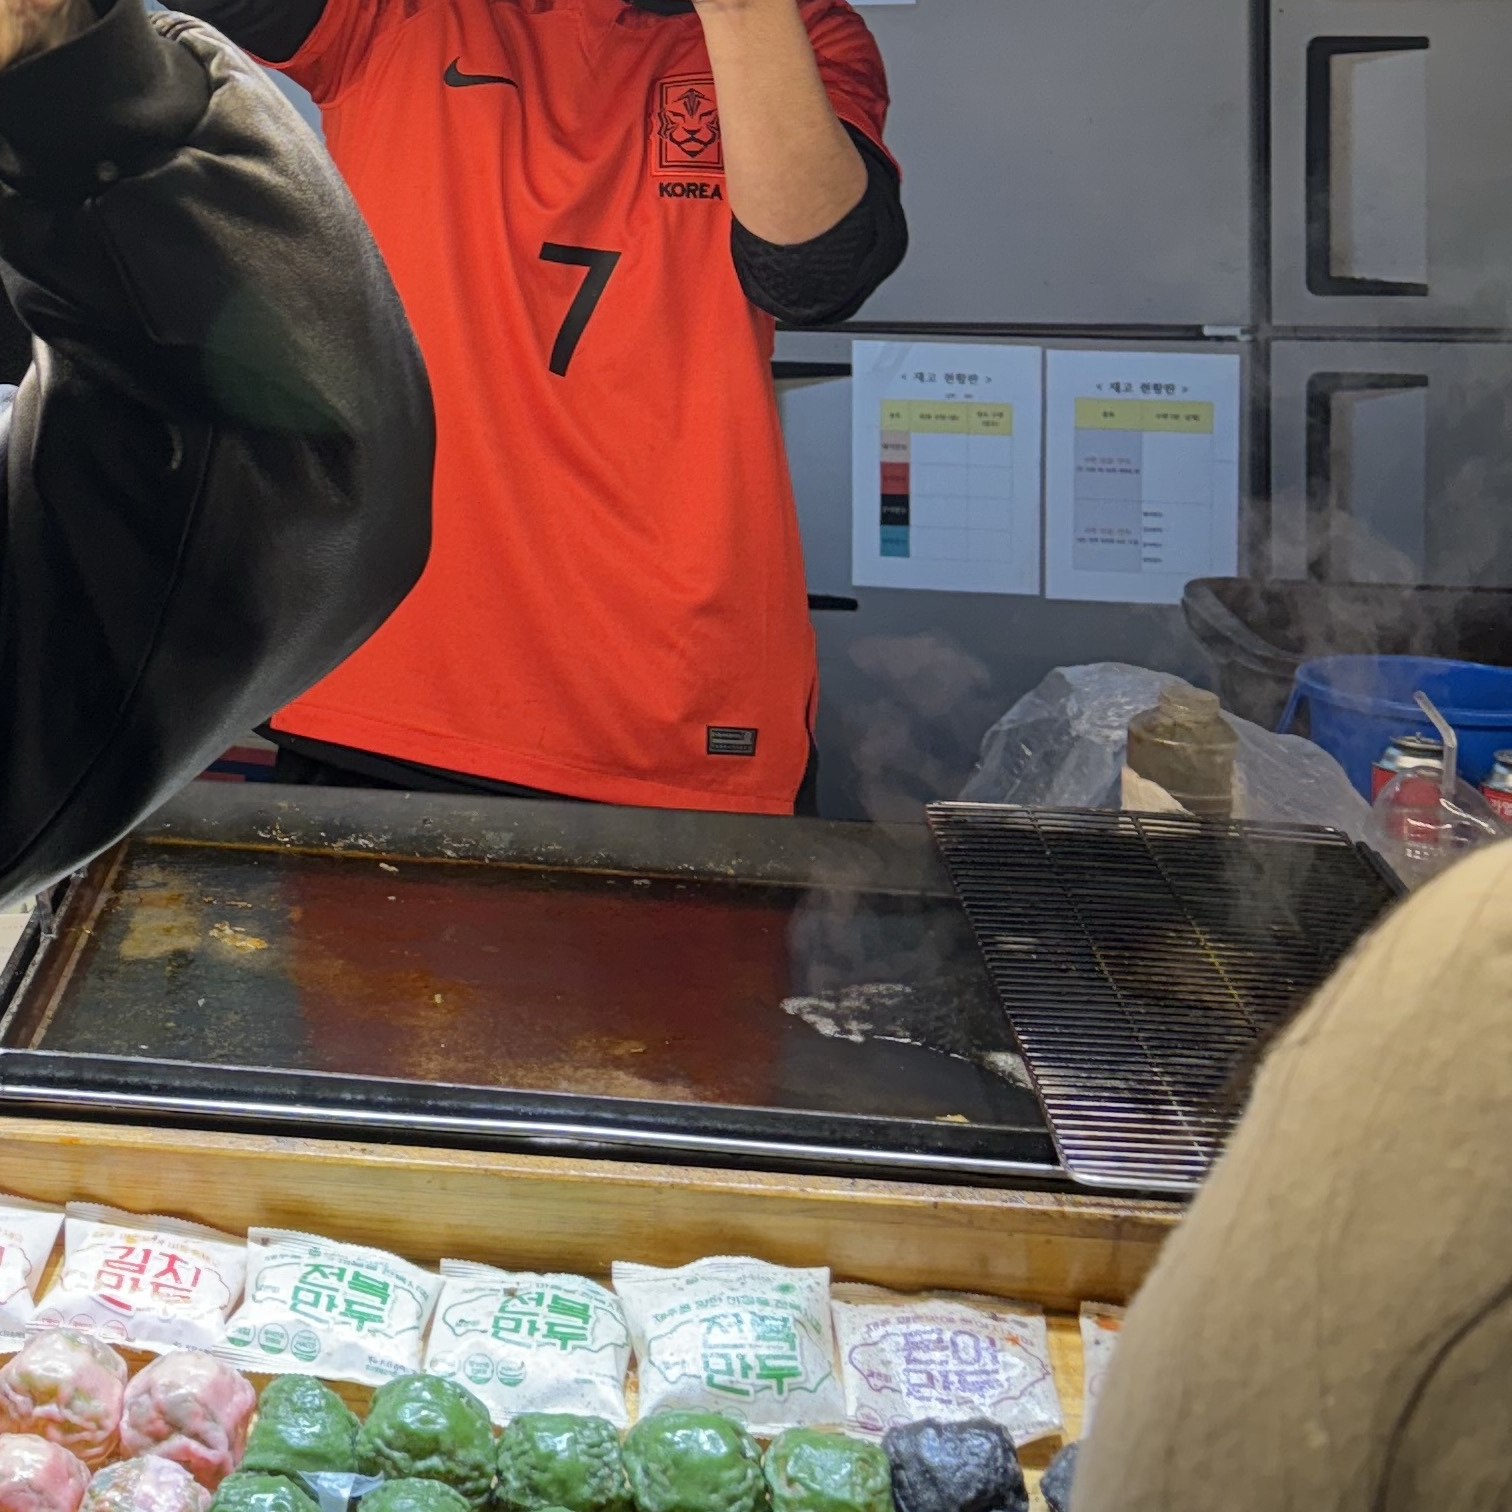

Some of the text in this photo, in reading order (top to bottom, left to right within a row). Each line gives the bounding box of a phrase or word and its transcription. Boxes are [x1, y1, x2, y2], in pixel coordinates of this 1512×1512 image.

[659, 182, 723, 201] KOREA
[539, 241, 622, 378] 7
[298, 1263, 391, 1306] 전복
[289, 1285, 386, 1332] 만두
[498, 1291, 592, 1326] 전복
[491, 1315, 589, 1351] 만두
[700, 1310, 797, 1352] 전복
[701, 1352, 802, 1396] 만두
